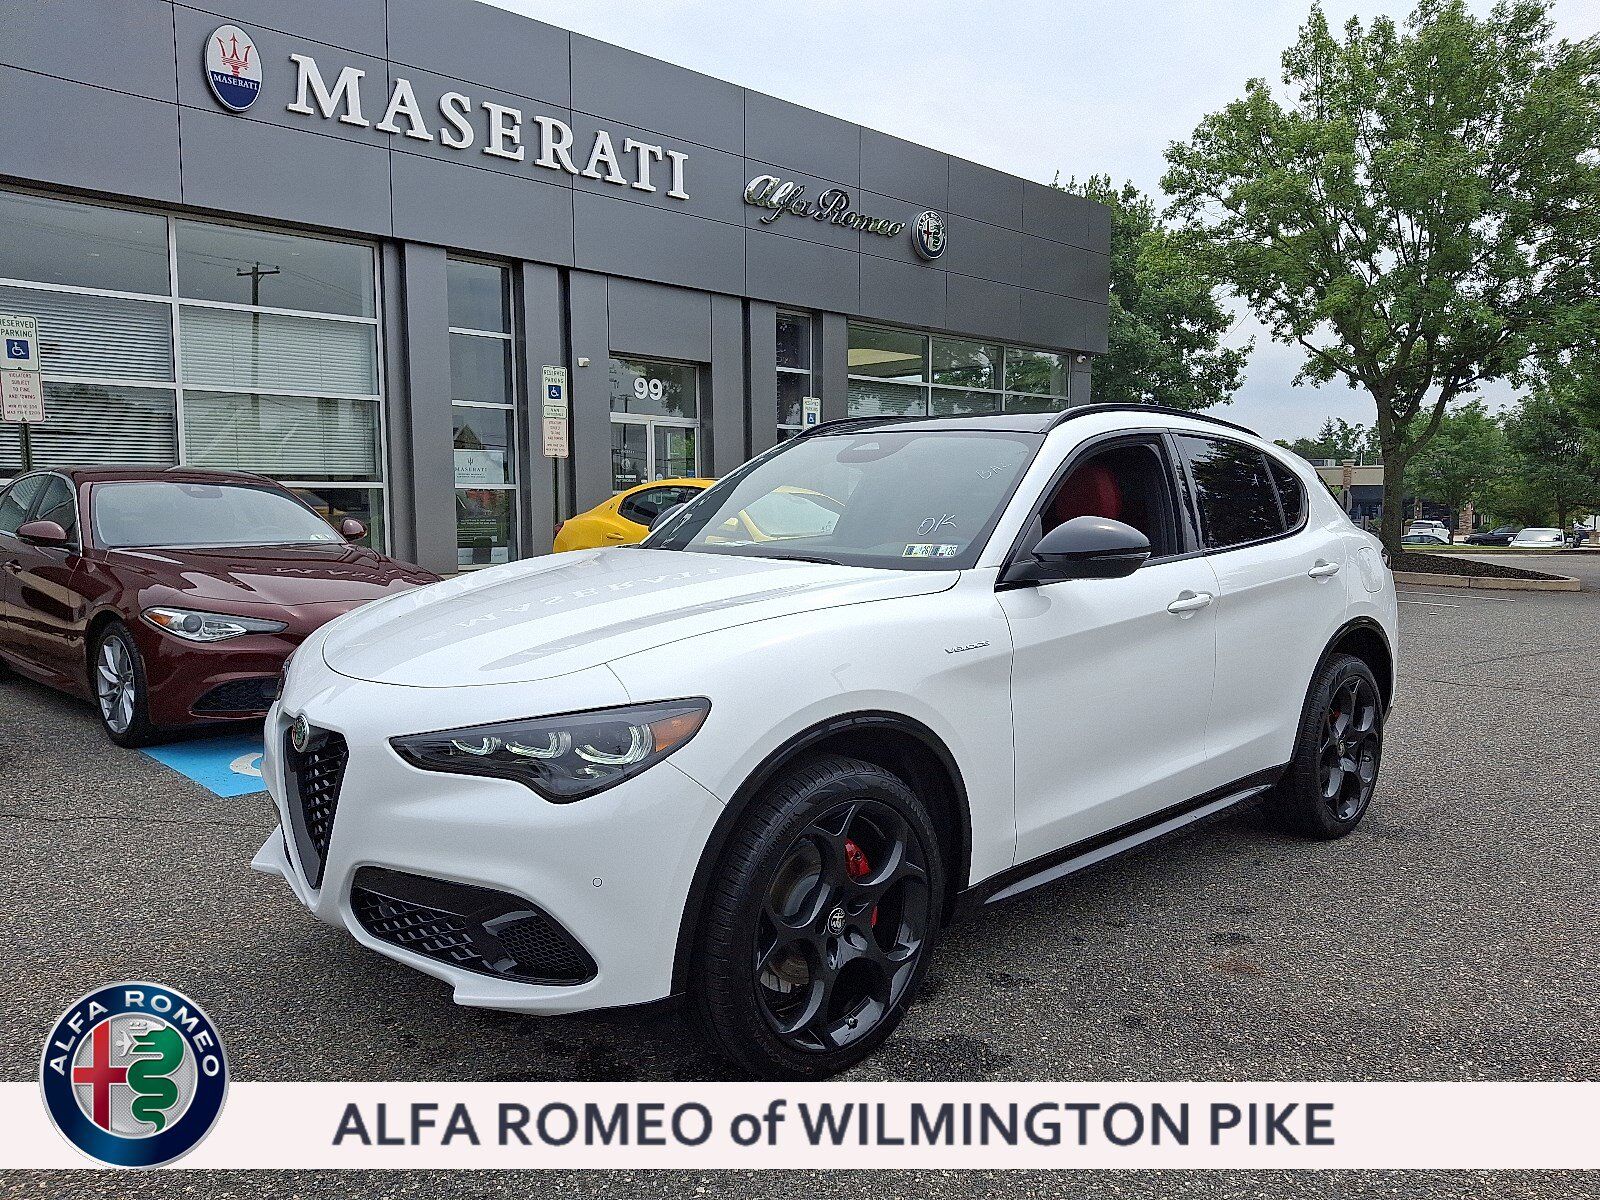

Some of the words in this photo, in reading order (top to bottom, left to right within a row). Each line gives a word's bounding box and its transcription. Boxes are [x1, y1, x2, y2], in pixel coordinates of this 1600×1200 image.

[213, 73, 258, 91] MASERATI
[286, 53, 690, 200] MASERATI
[743, 174, 816, 224] Alfa
[813, 188, 906, 237] Romeo
[0, 328, 33, 338] PARKING
[633, 377, 663, 400] 99
[917, 514, 958, 536] OK
